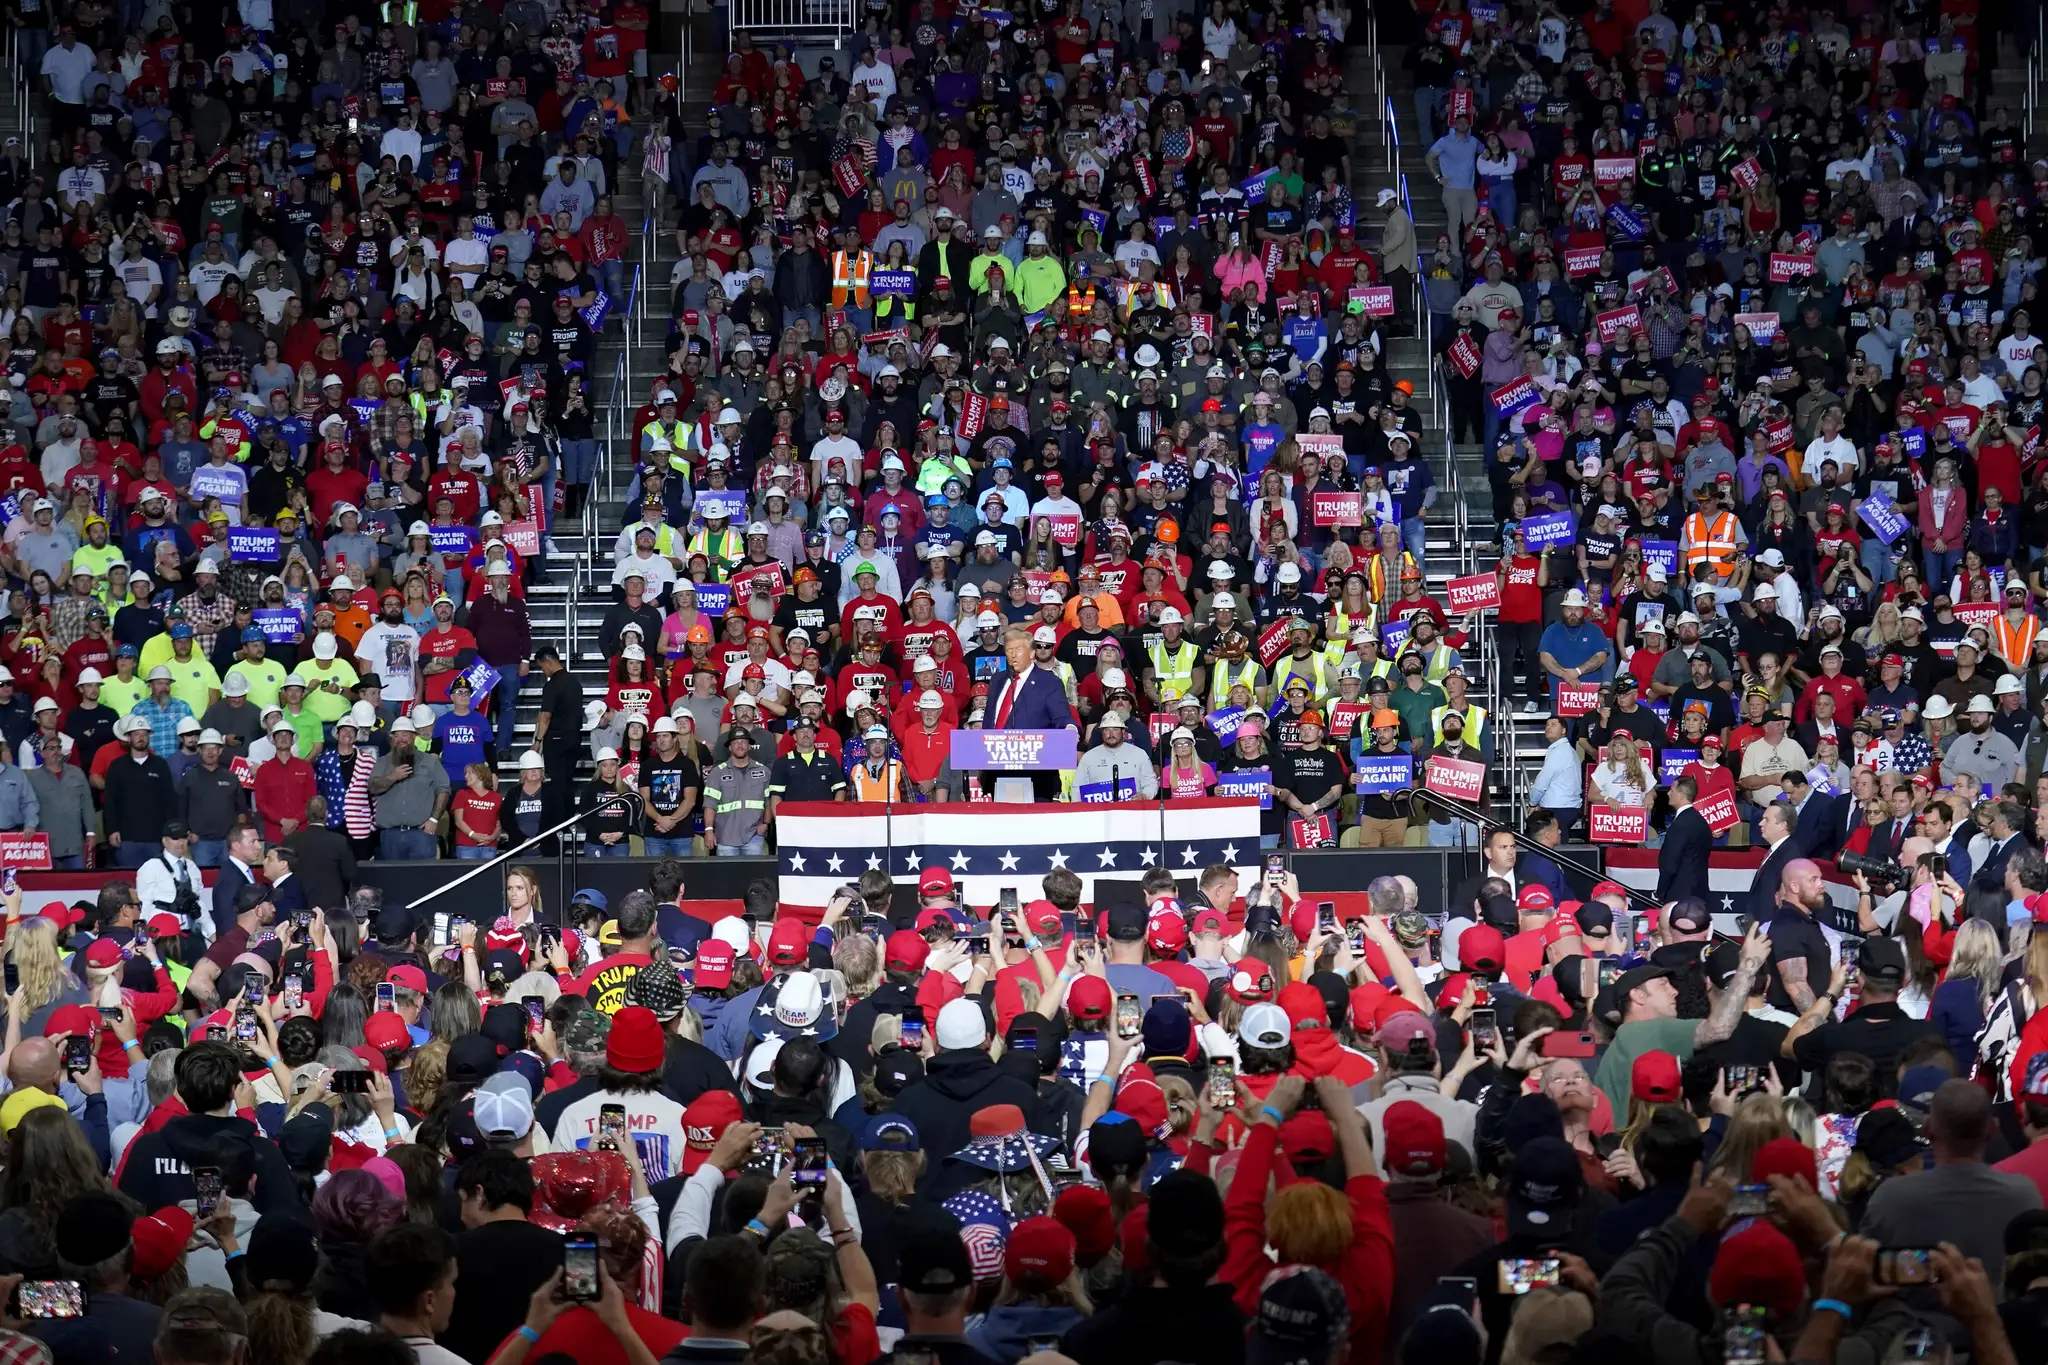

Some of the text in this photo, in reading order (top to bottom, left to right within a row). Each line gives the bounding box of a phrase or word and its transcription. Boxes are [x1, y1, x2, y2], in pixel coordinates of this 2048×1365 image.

[1597, 166, 1632, 174] TRUMP
[1562, 172, 1580, 180] 2024
[288, 212, 311, 220] TRUMP
[1773, 260, 1811, 271] TRUMP
[1600, 312, 1637, 328] TRUMP
[1749, 321, 1776, 330] RUMP
[1457, 338, 1478, 366] TRUMP
[2010, 349, 2032, 361] USA
[1496, 381, 1531, 404] TRUMP
[1500, 390, 1533, 410] AGAIN!
[965, 395, 977, 435] TRUMP
[197, 483, 238, 494] AGAIN!
[224, 479, 240, 488] BIG,
[1316, 501, 1358, 511] TRUMP
[1867, 504, 1894, 535] AGAIN!
[1528, 521, 1568, 535] AGAIN!
[231, 536, 275, 546] TRUMP
[1526, 534, 1543, 542] BIG,
[1586, 538, 1614, 549] TRUMP
[1588, 545, 1610, 555] 2024
[1508, 567, 1535, 575] Trump
[1508, 575, 1533, 584] 2024
[1450, 582, 1495, 598] TRUMP
[1453, 595, 1471, 604] WILL
[1953, 609, 1998, 620] TRUMP
[796, 615, 824, 626] TRUMP
[263, 624, 295, 633] GAIN!
[1259, 624, 1290, 653] TRUMP
[449, 734, 474, 742] MAGA
[984, 740, 1043, 752] TRUMP
[990, 751, 1036, 760] VANCE
[1362, 772, 1404, 783] AGAIN!
[1433, 766, 1482, 783] TRUMP
[1431, 776, 1449, 785] WILL
[1450, 780, 1466, 788] FIX
[1222, 782, 1268, 794] TRUMP
[1084, 788, 1133, 802] TRUMP
[468, 799, 494, 807] TRUMP
[1594, 814, 1642, 826] TRUMP
[4, 849, 45, 859] AGAIN!
[780, 1008, 806, 1016] TEAM
[780, 1013, 808, 1023] TRUMP
[688, 1125, 713, 1140] 10X
[155, 1157, 177, 1174] I'LL
[1262, 1300, 1314, 1322] TRUMP
